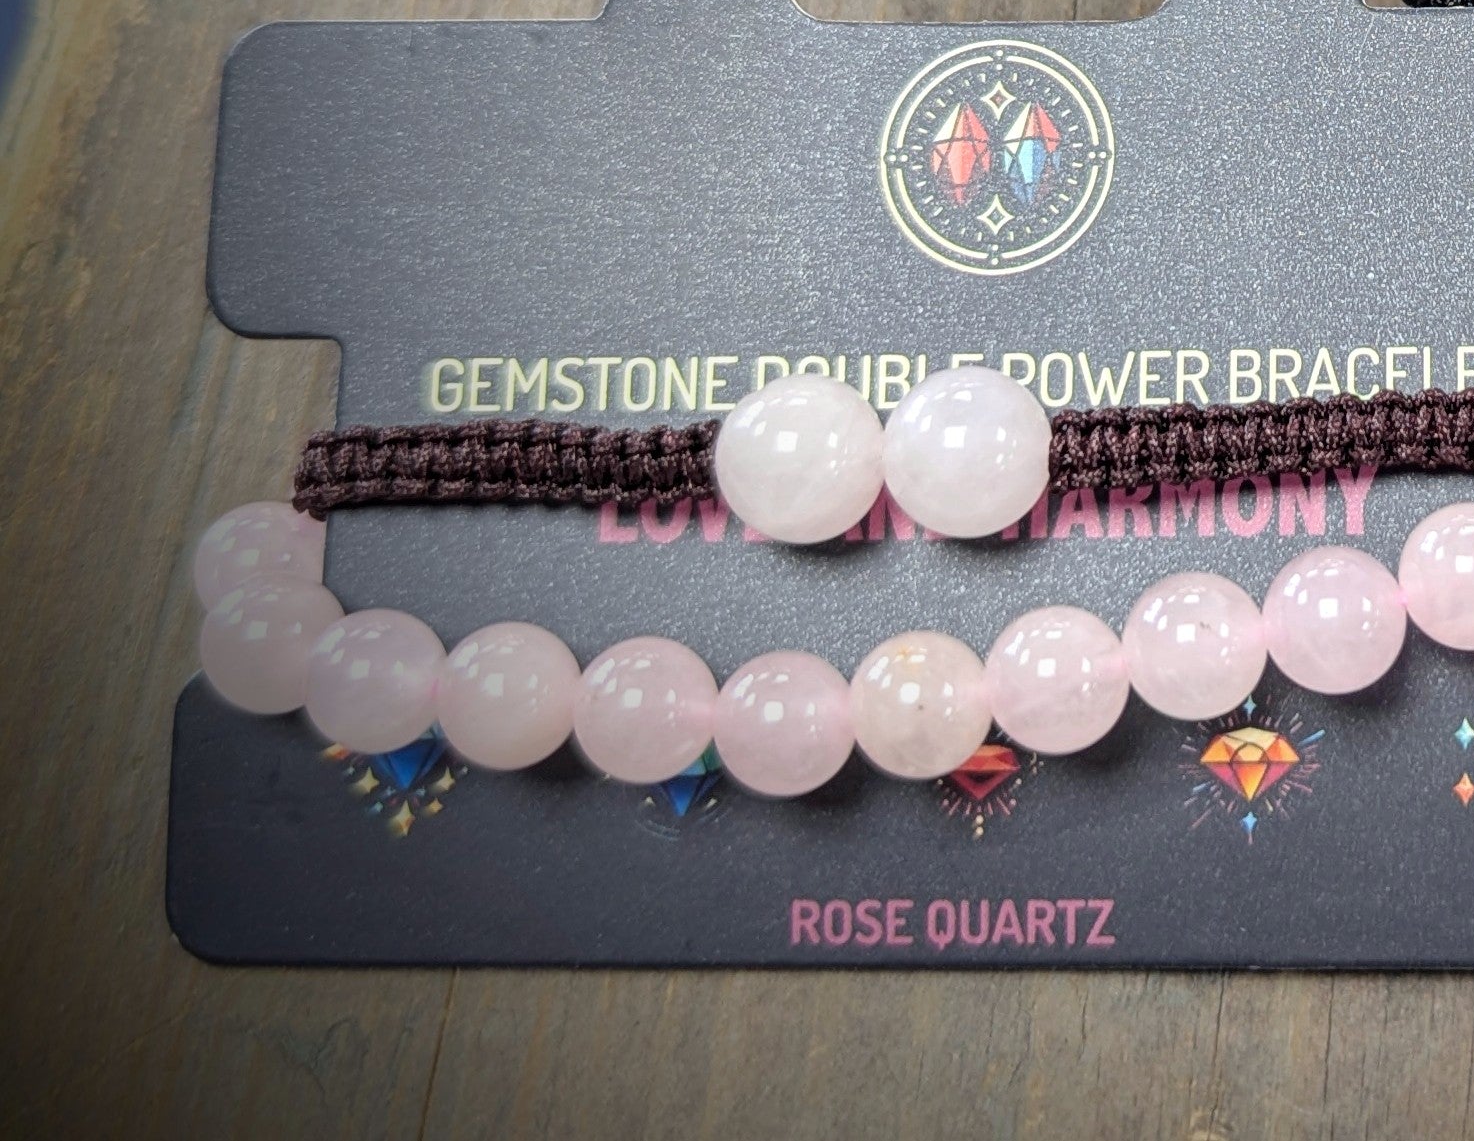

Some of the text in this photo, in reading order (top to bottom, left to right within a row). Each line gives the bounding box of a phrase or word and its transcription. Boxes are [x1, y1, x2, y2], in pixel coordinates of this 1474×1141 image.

[429, 356, 739, 412] GEMSTONE
[756, 353, 984, 409] DUB
[1002, 349, 1209, 407] POWER
[599, 496, 770, 542] LOV
[790, 898, 1116, 951] ROSE QUARTZ
